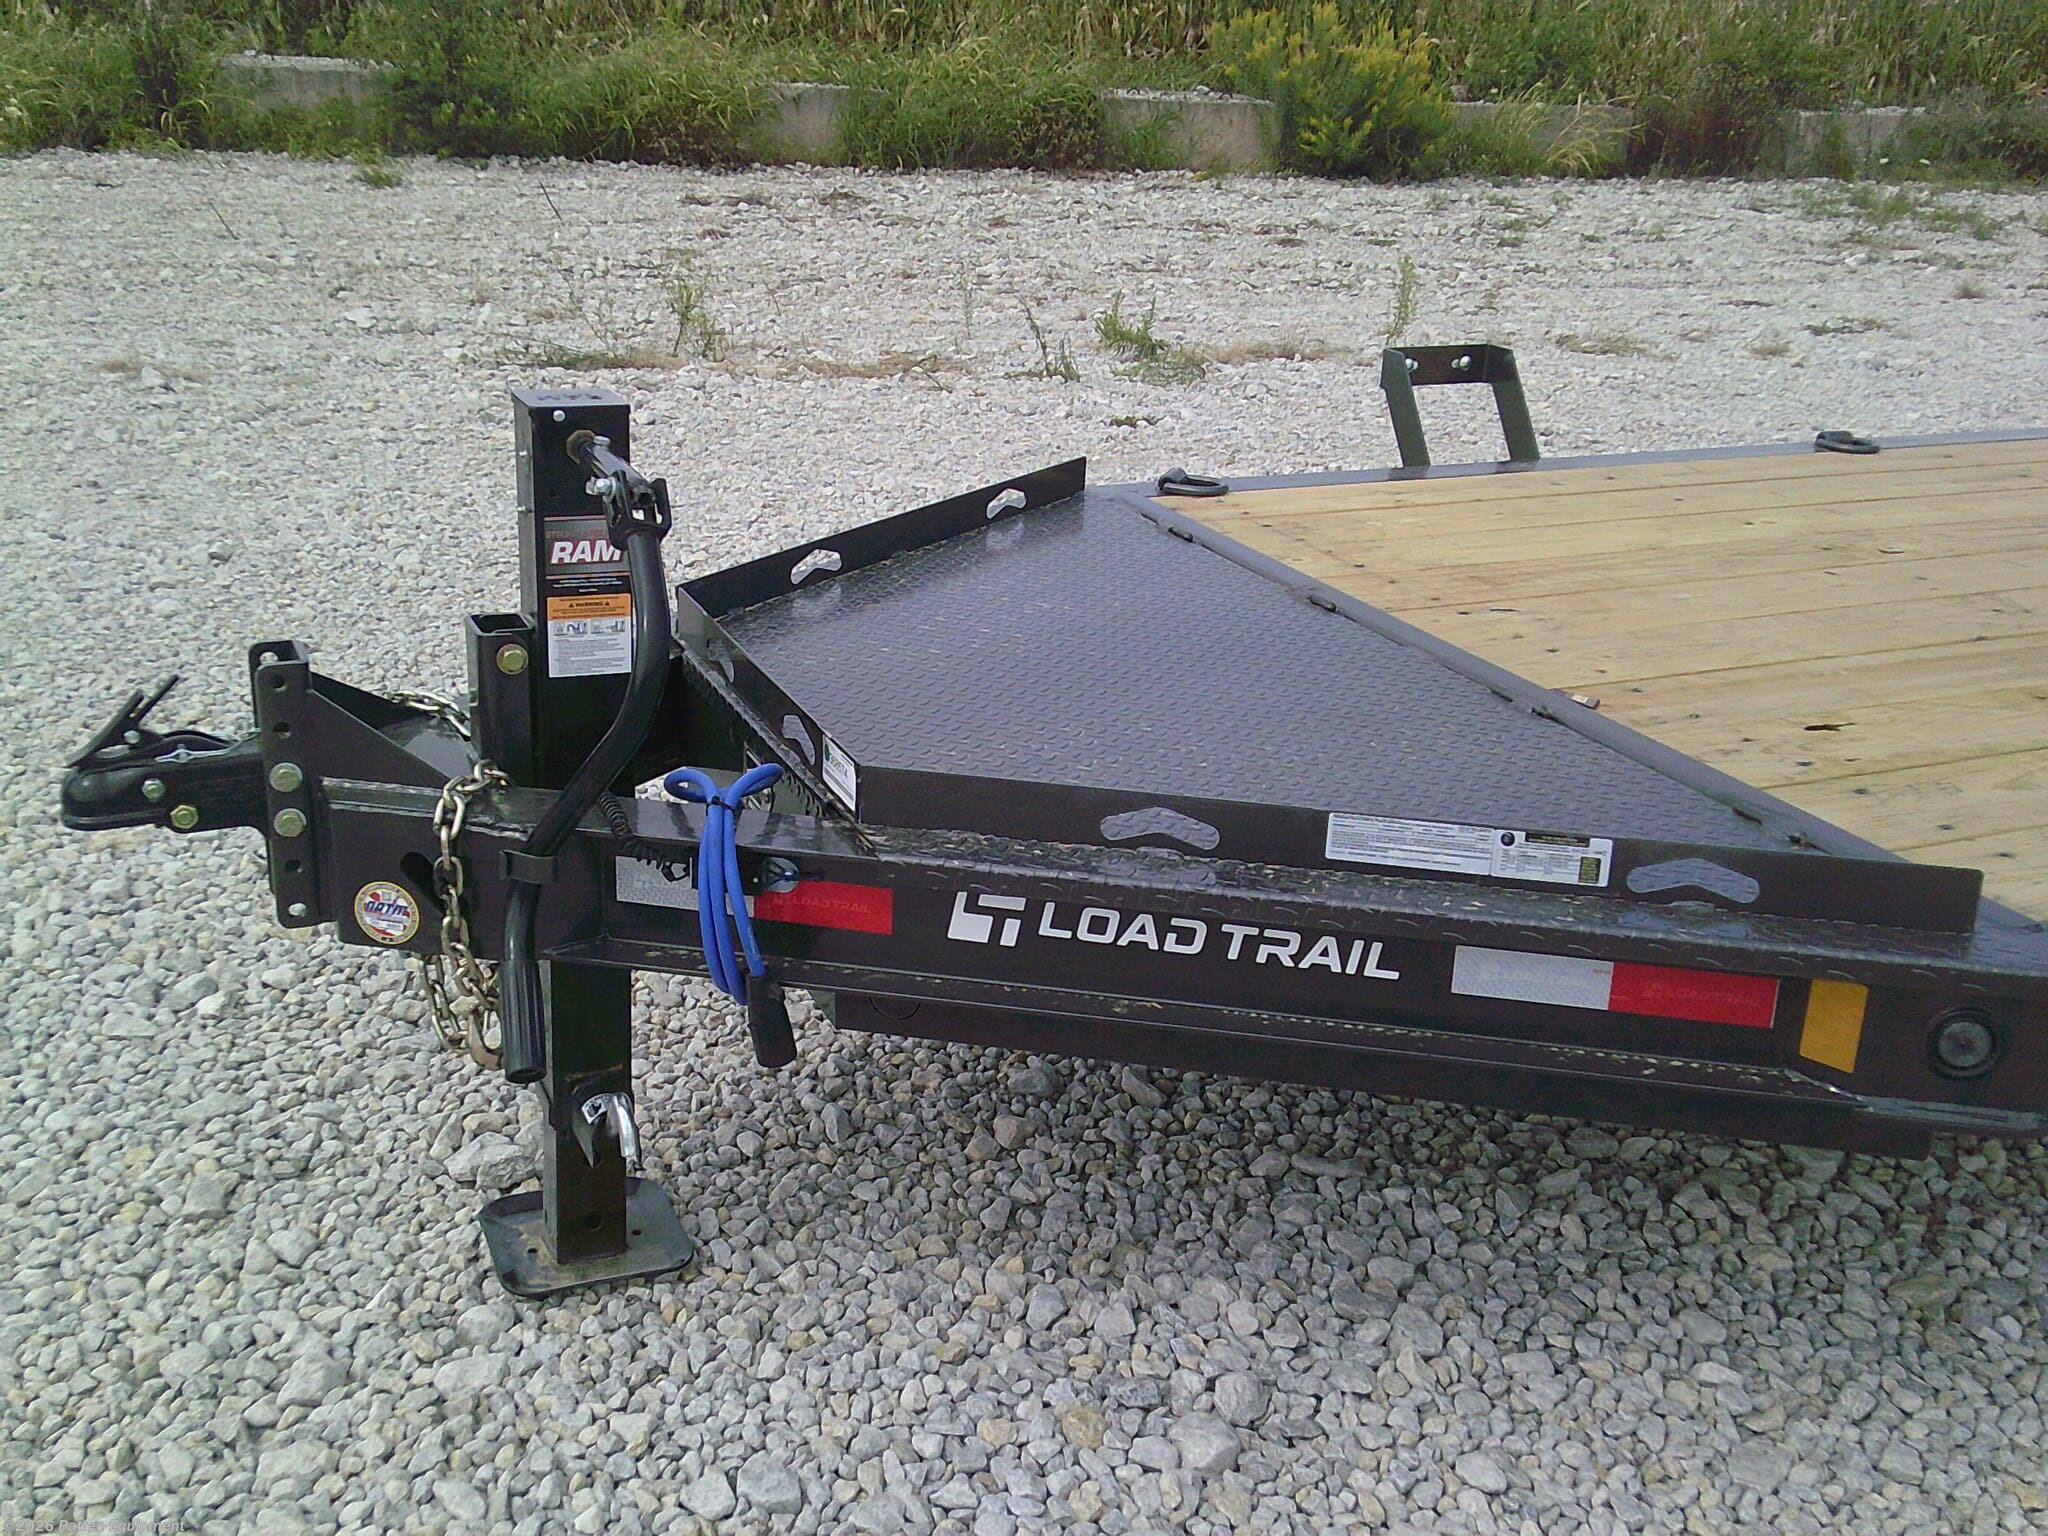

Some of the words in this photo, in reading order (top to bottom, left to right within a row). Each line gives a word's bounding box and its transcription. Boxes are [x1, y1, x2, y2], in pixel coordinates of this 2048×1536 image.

[550, 539, 622, 564] RAM
[1038, 901, 1207, 954] LOAD
[1220, 923, 1400, 980] TRAIL
